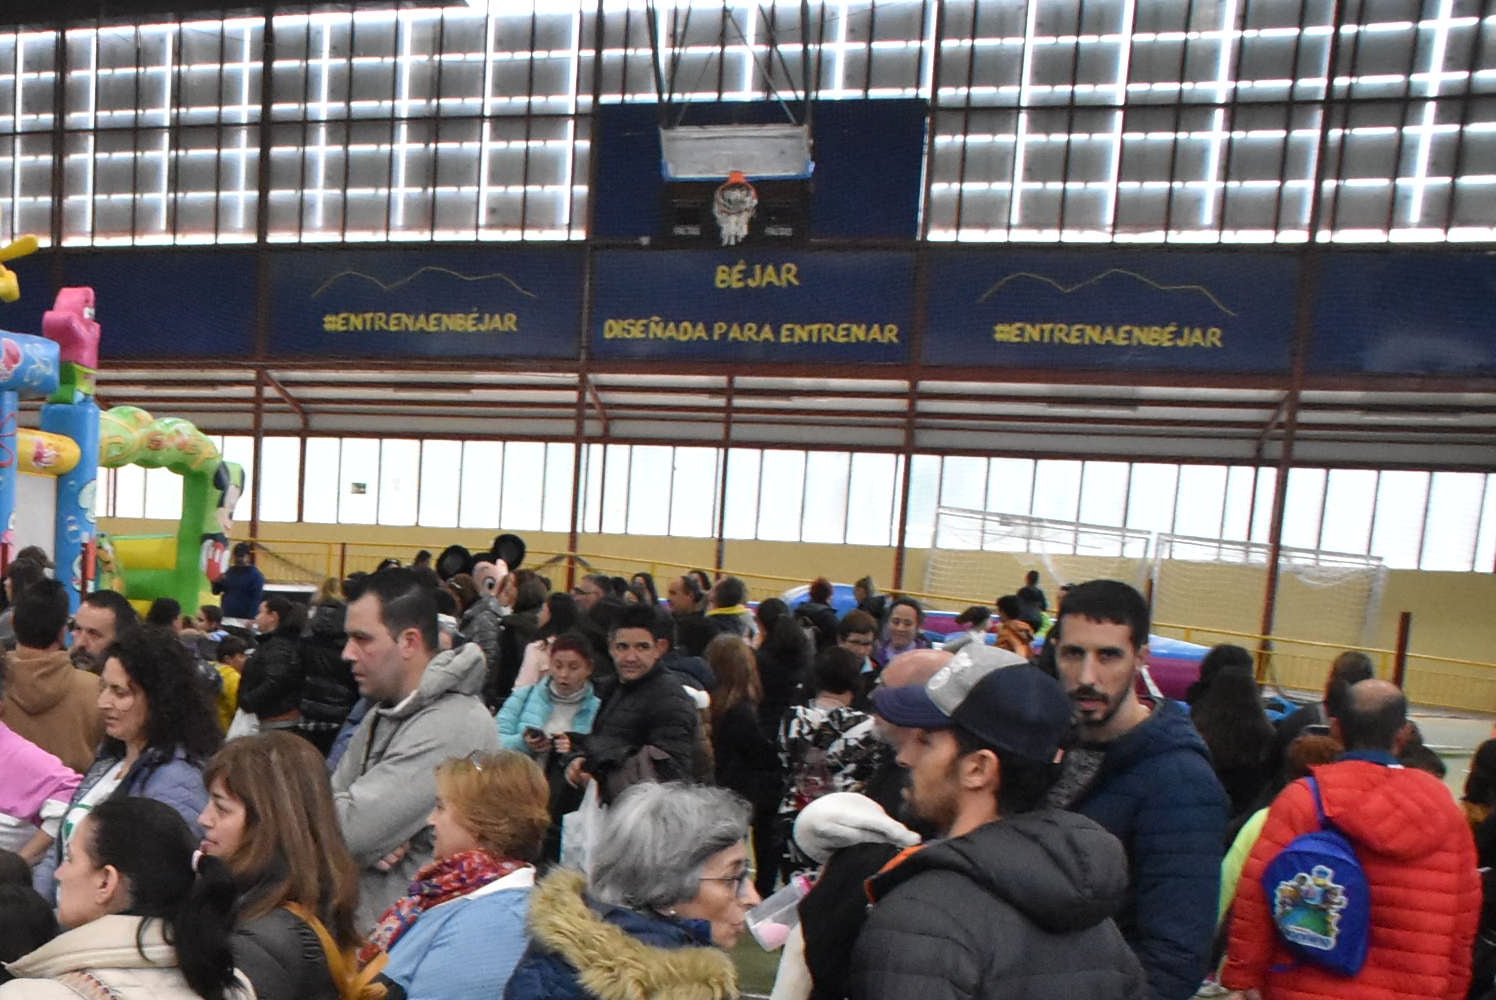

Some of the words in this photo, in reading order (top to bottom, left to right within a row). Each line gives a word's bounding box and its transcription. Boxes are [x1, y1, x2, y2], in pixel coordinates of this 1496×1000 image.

[714, 259, 800, 289] BÉJAR
[322, 307, 518, 332] #ENTRENAENBÉJAR
[603, 316, 709, 342] DISEÑADA
[713, 321, 775, 342] PARA
[780, 323, 899, 344] ENTRENAR
[993, 321, 1223, 348] #ENTRENAENBÉJAR
